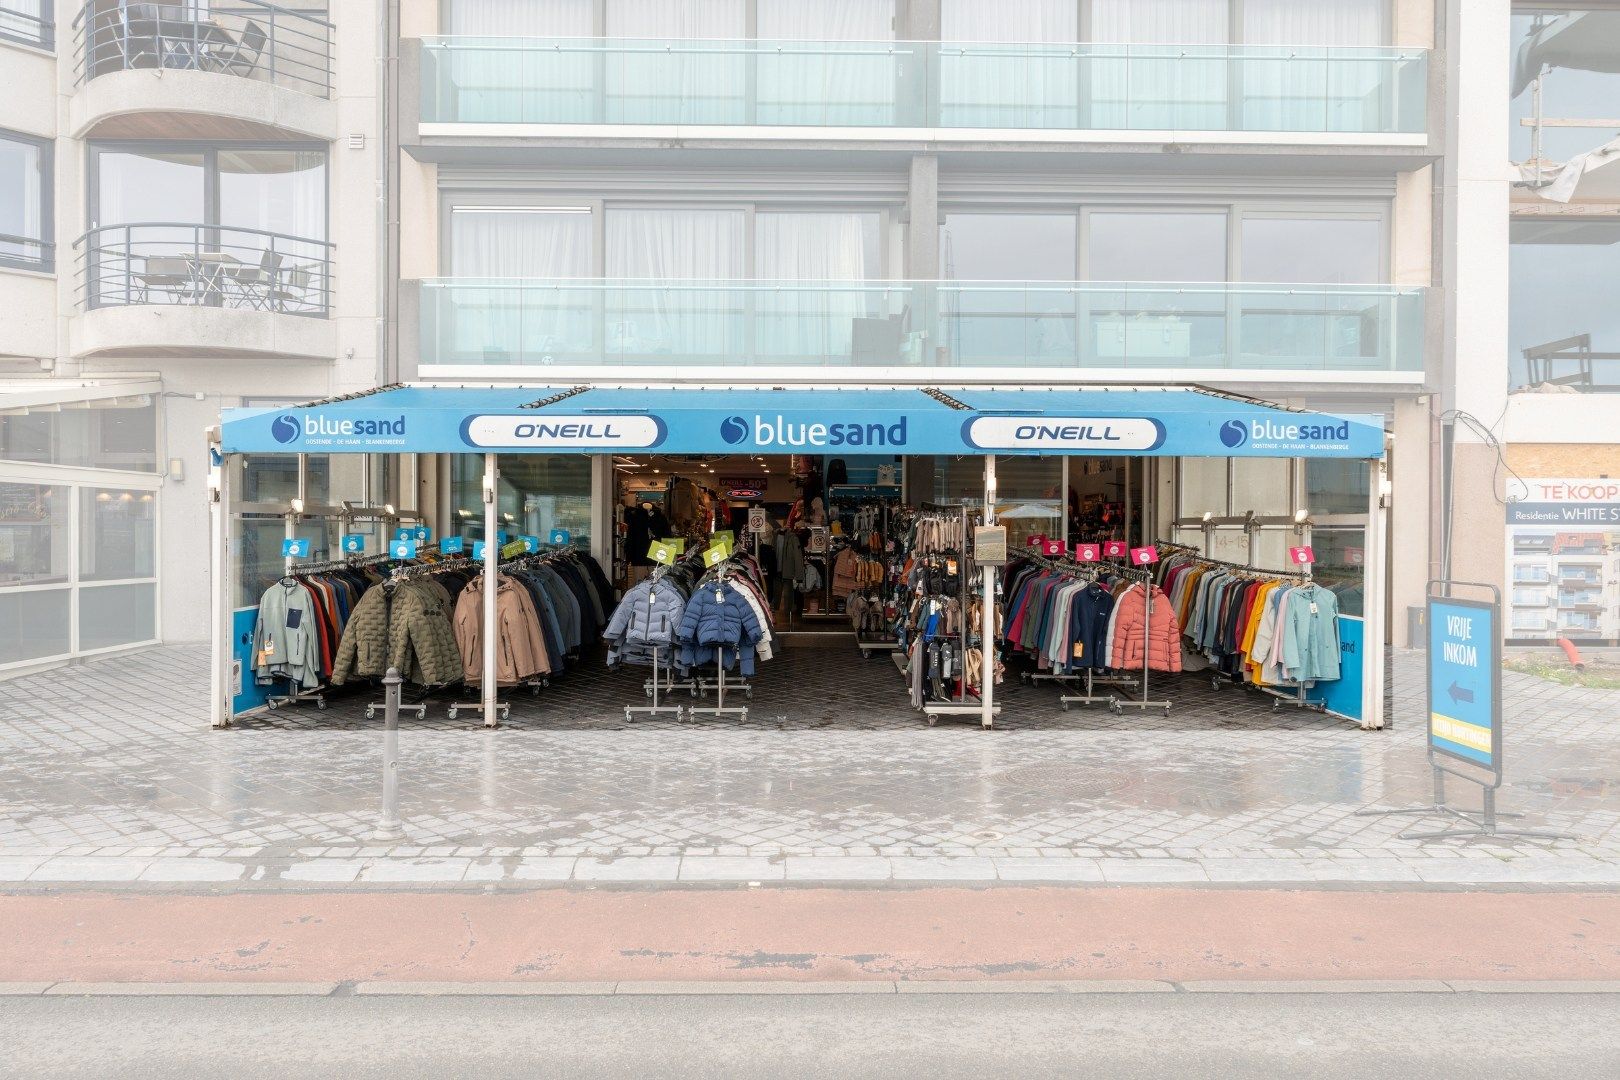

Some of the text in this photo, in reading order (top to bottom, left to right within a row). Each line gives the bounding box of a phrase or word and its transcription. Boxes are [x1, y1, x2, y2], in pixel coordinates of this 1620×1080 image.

[305, 415, 405, 435] bluesand
[514, 424, 621, 438] O'NEILL
[755, 415, 907, 446] bluesand
[1015, 426, 1121, 440] O'NEILL
[1252, 420, 1349, 440] bluesand
[1541, 485, 1618, 500] TE KOOP
[1515, 507, 1620, 520] Residentie WHITE S
[1447, 615, 1472, 641] VRIJE
[1443, 641, 1477, 667] INKOM
